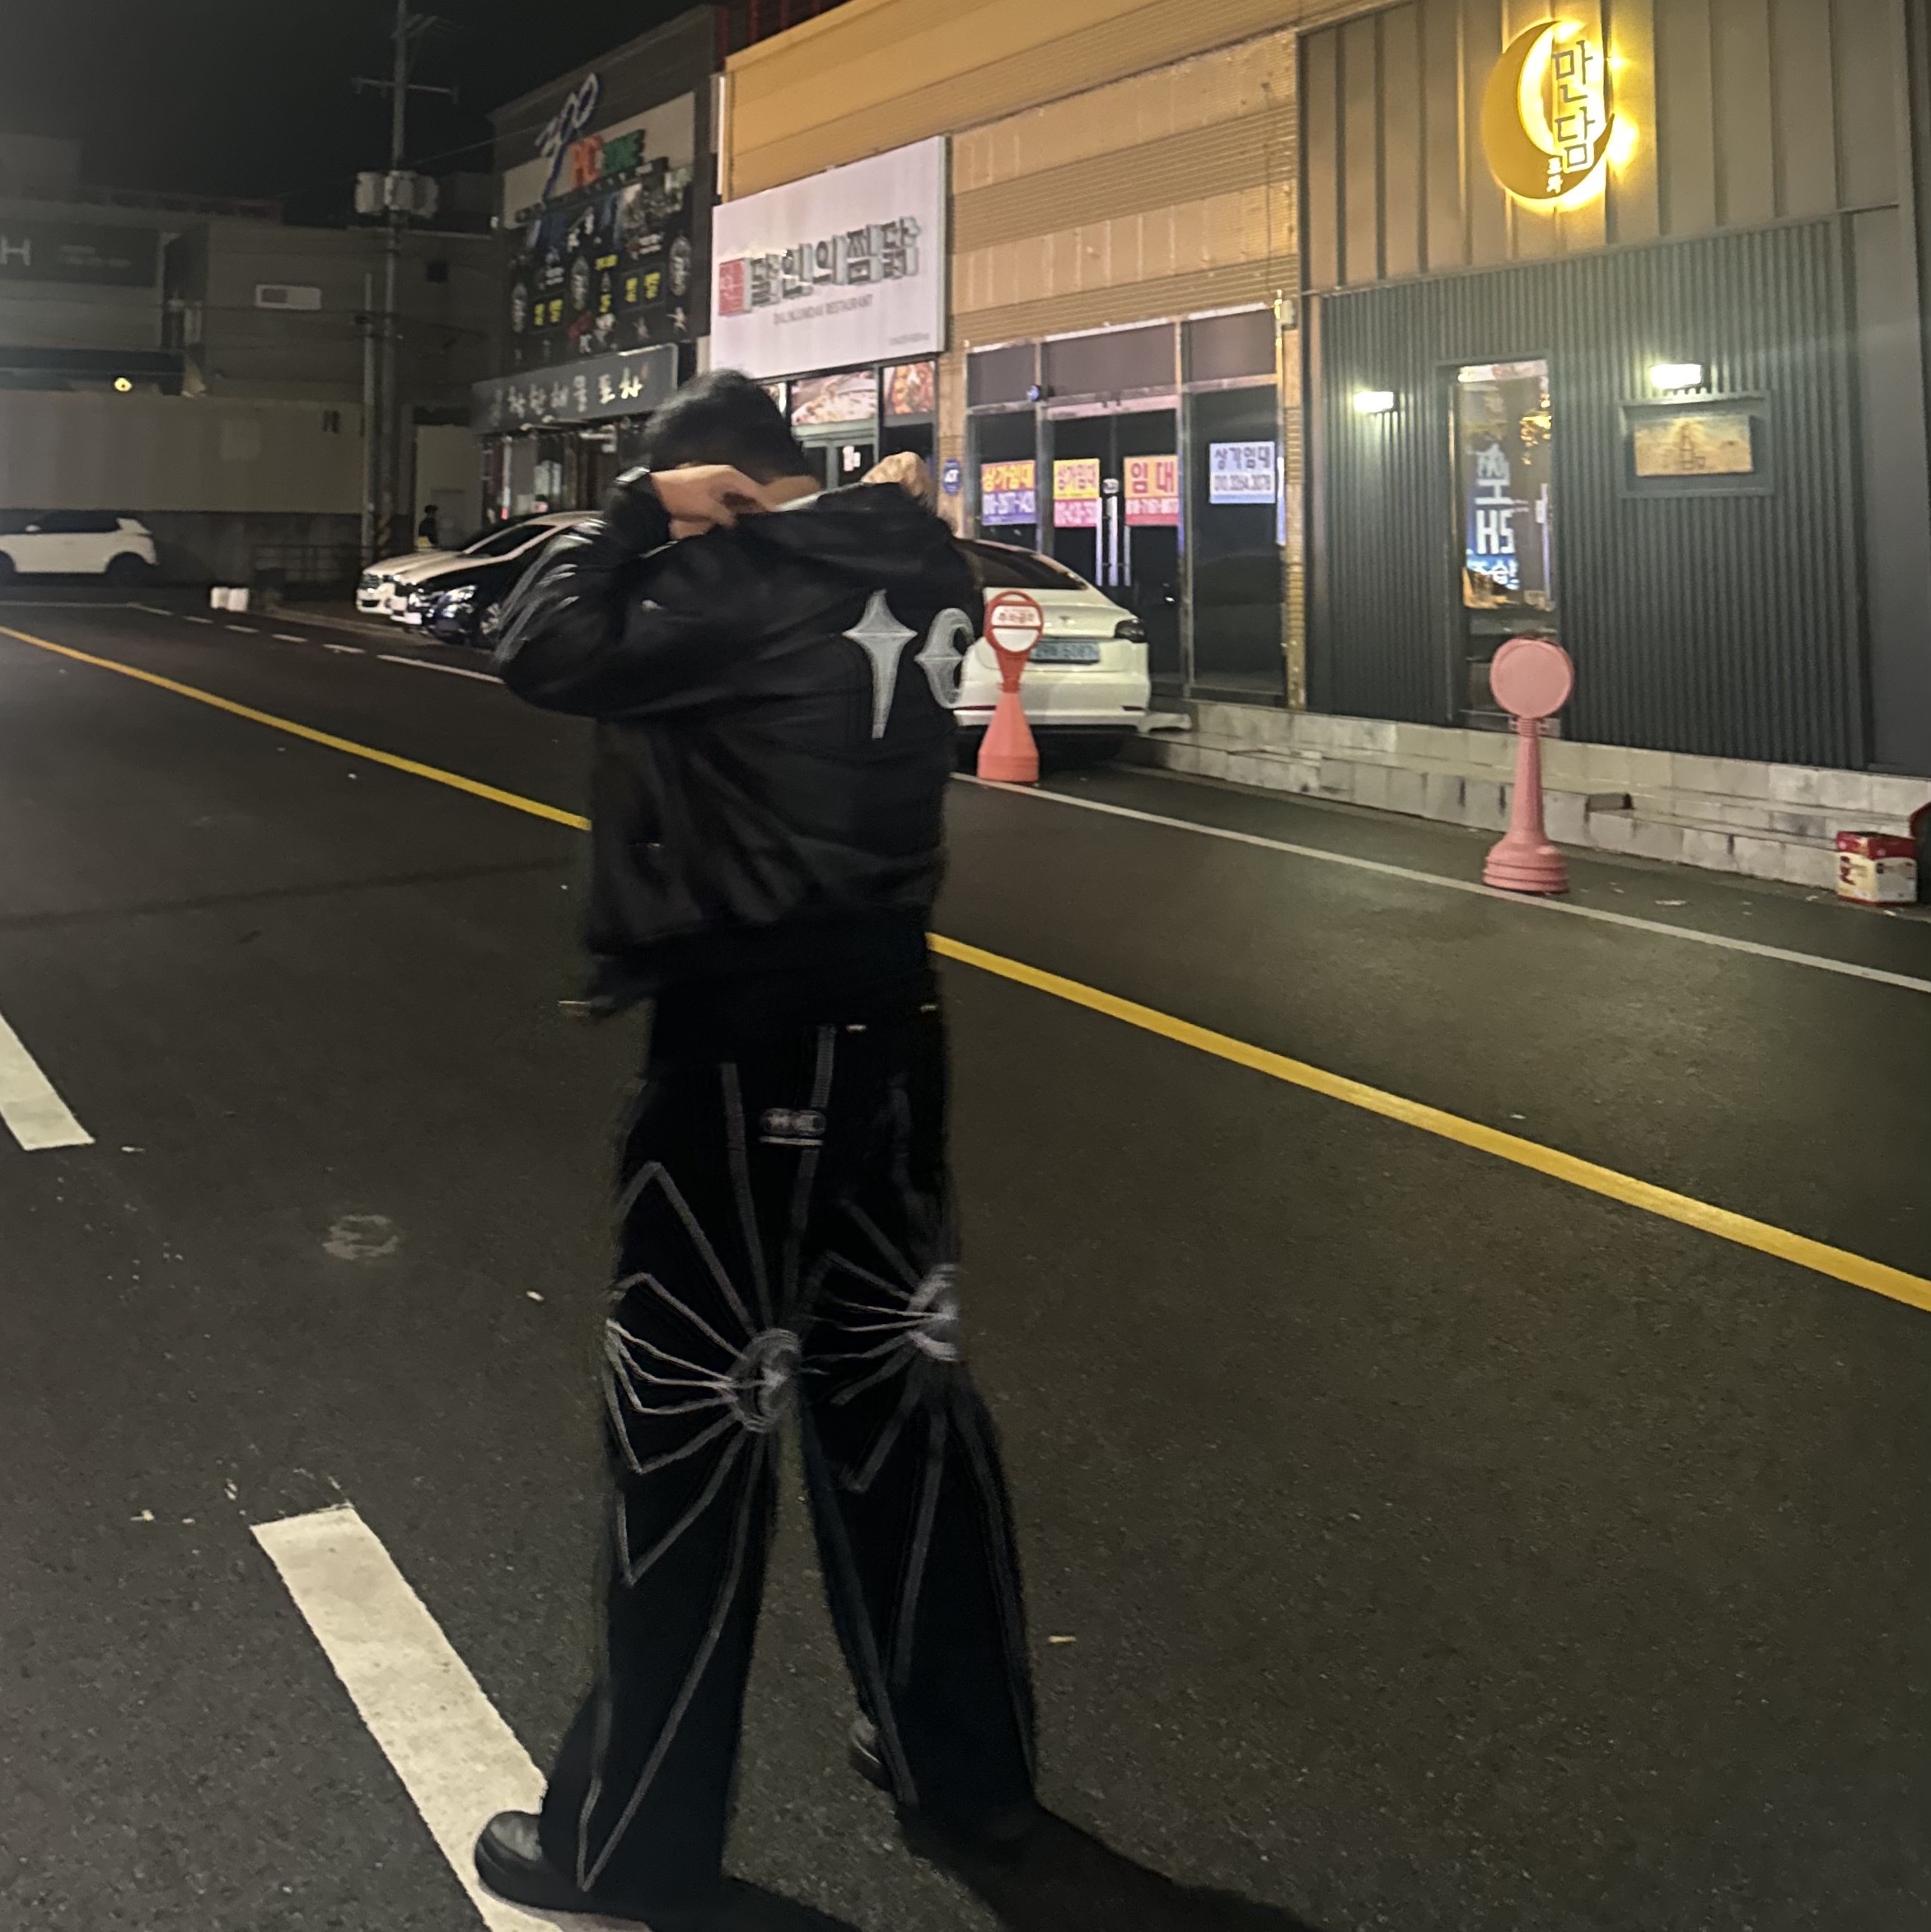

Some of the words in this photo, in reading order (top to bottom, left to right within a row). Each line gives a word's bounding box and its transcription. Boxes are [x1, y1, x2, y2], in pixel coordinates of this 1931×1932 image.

[1552, 40, 1596, 168] 만담
[1214, 446, 1271, 470] 상가임대
[983, 464, 1034, 492] 상가임대
